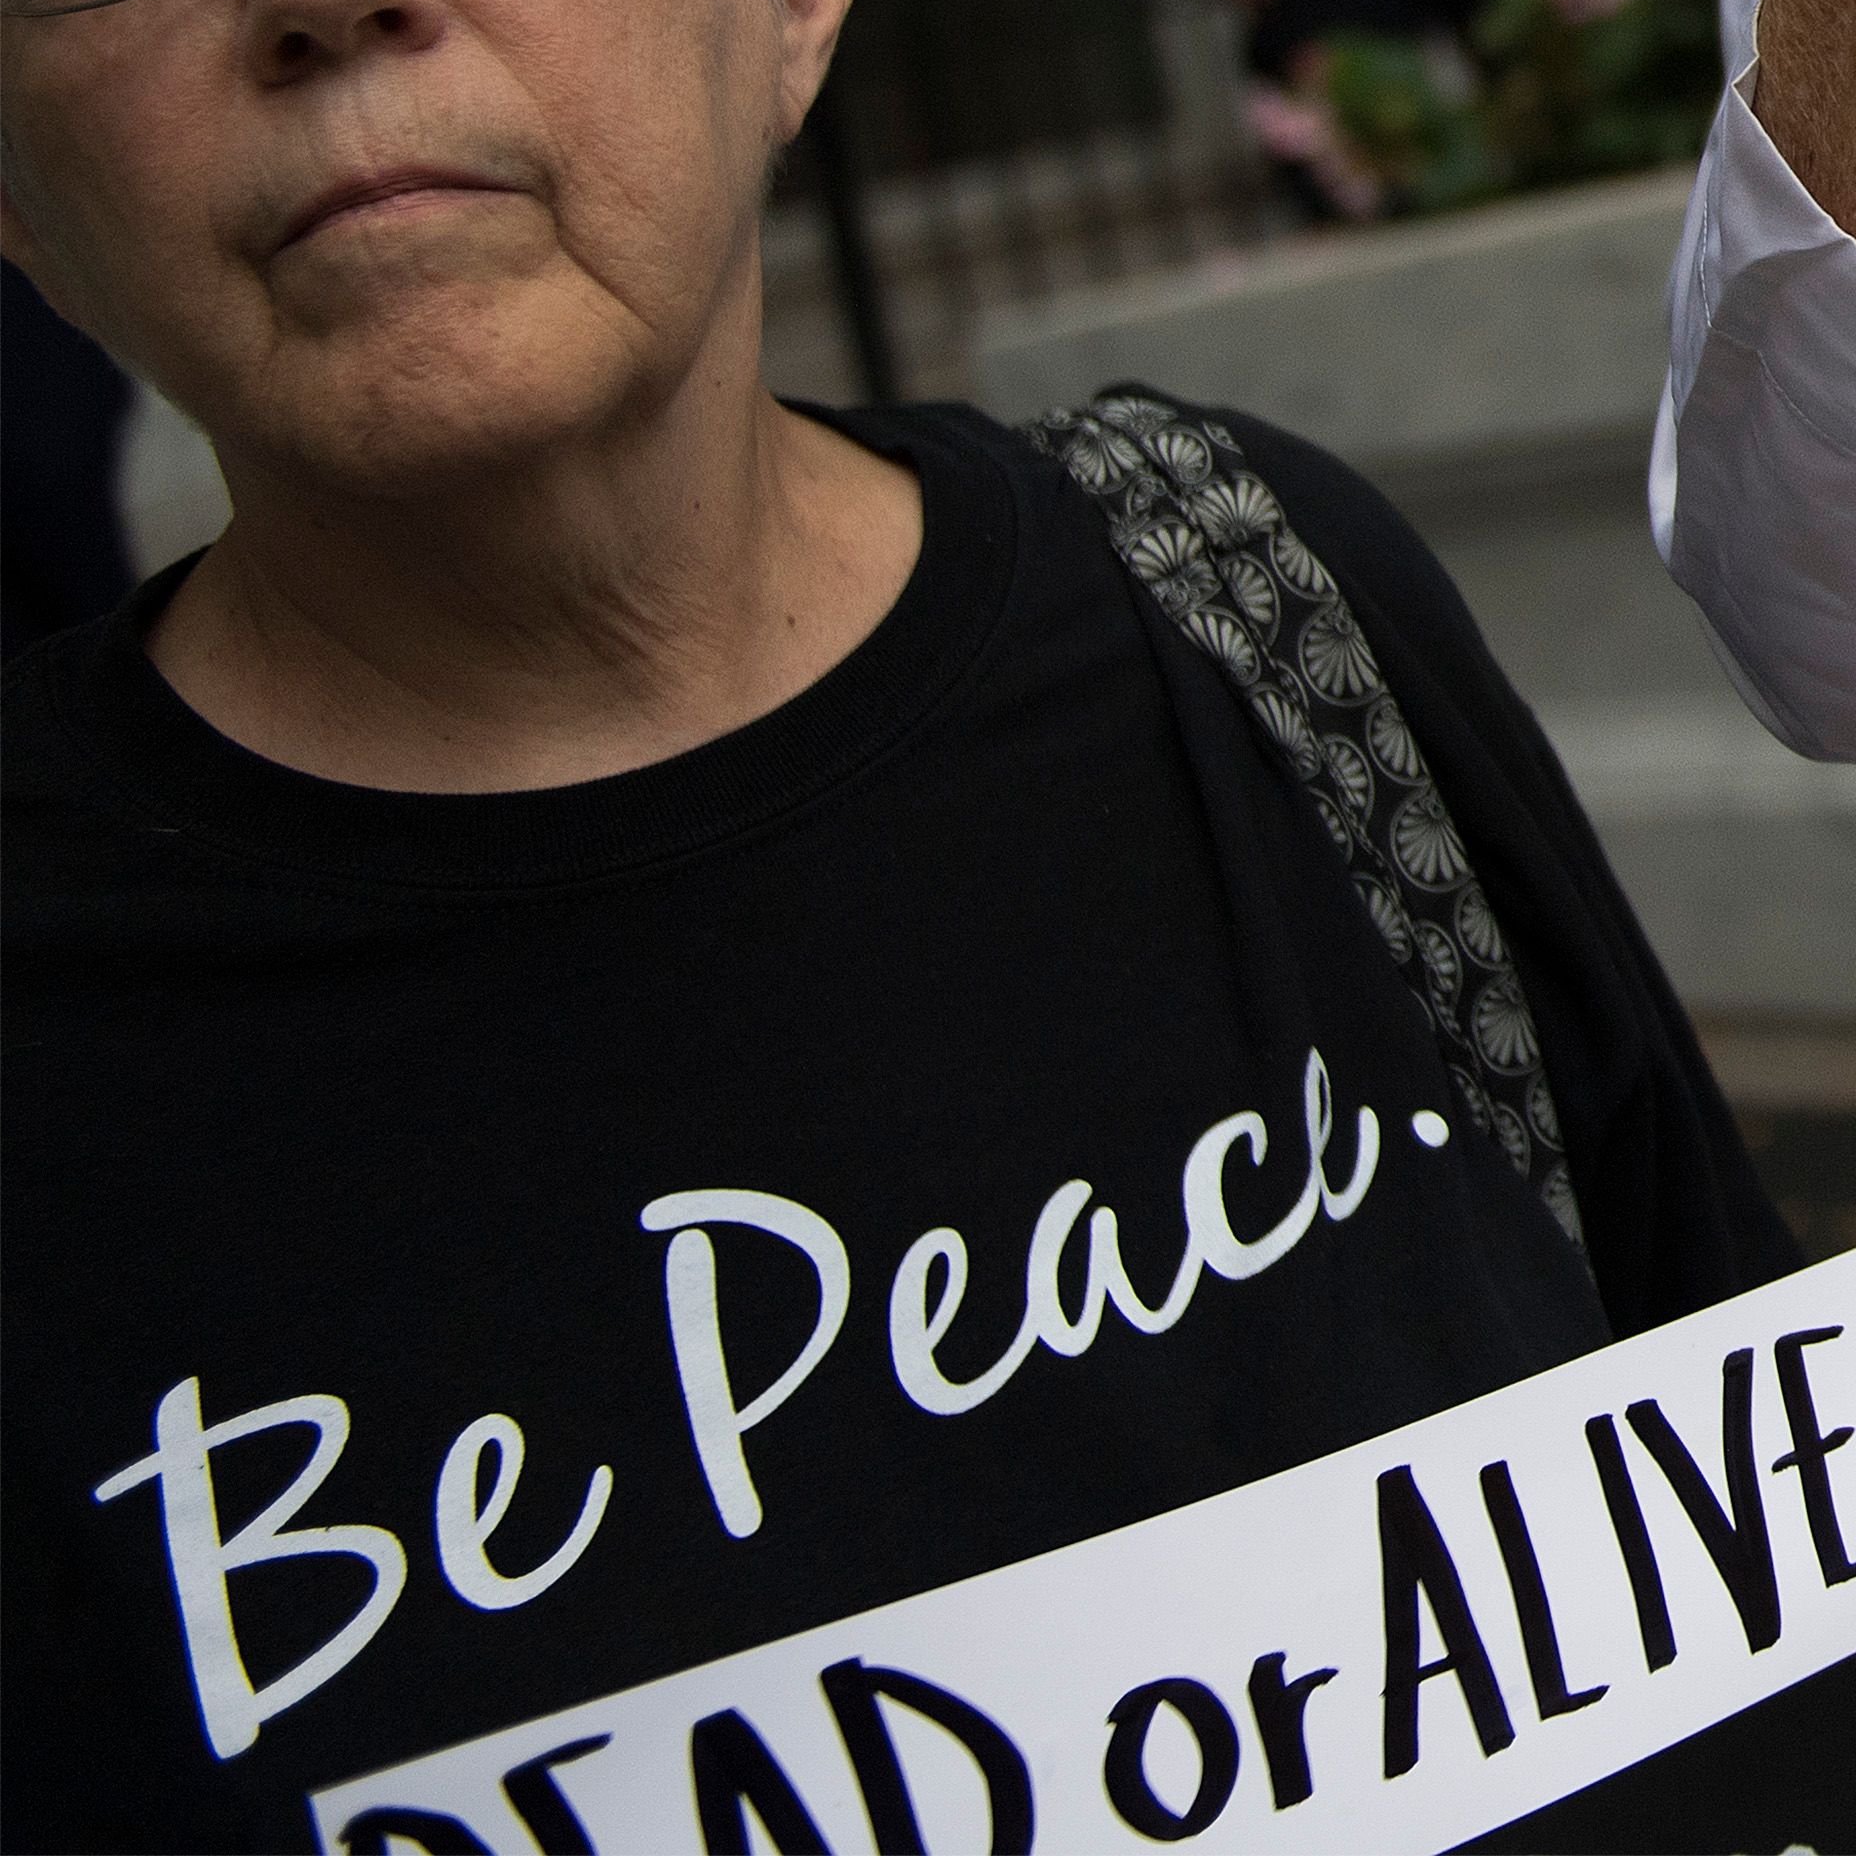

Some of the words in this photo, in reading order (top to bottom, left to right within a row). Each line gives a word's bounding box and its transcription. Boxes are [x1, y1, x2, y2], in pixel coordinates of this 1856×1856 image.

[94, 1375, 613, 1760] Be
[640, 1045, 1453, 1541] Peace.
[1102, 1649, 1338, 1844] or
